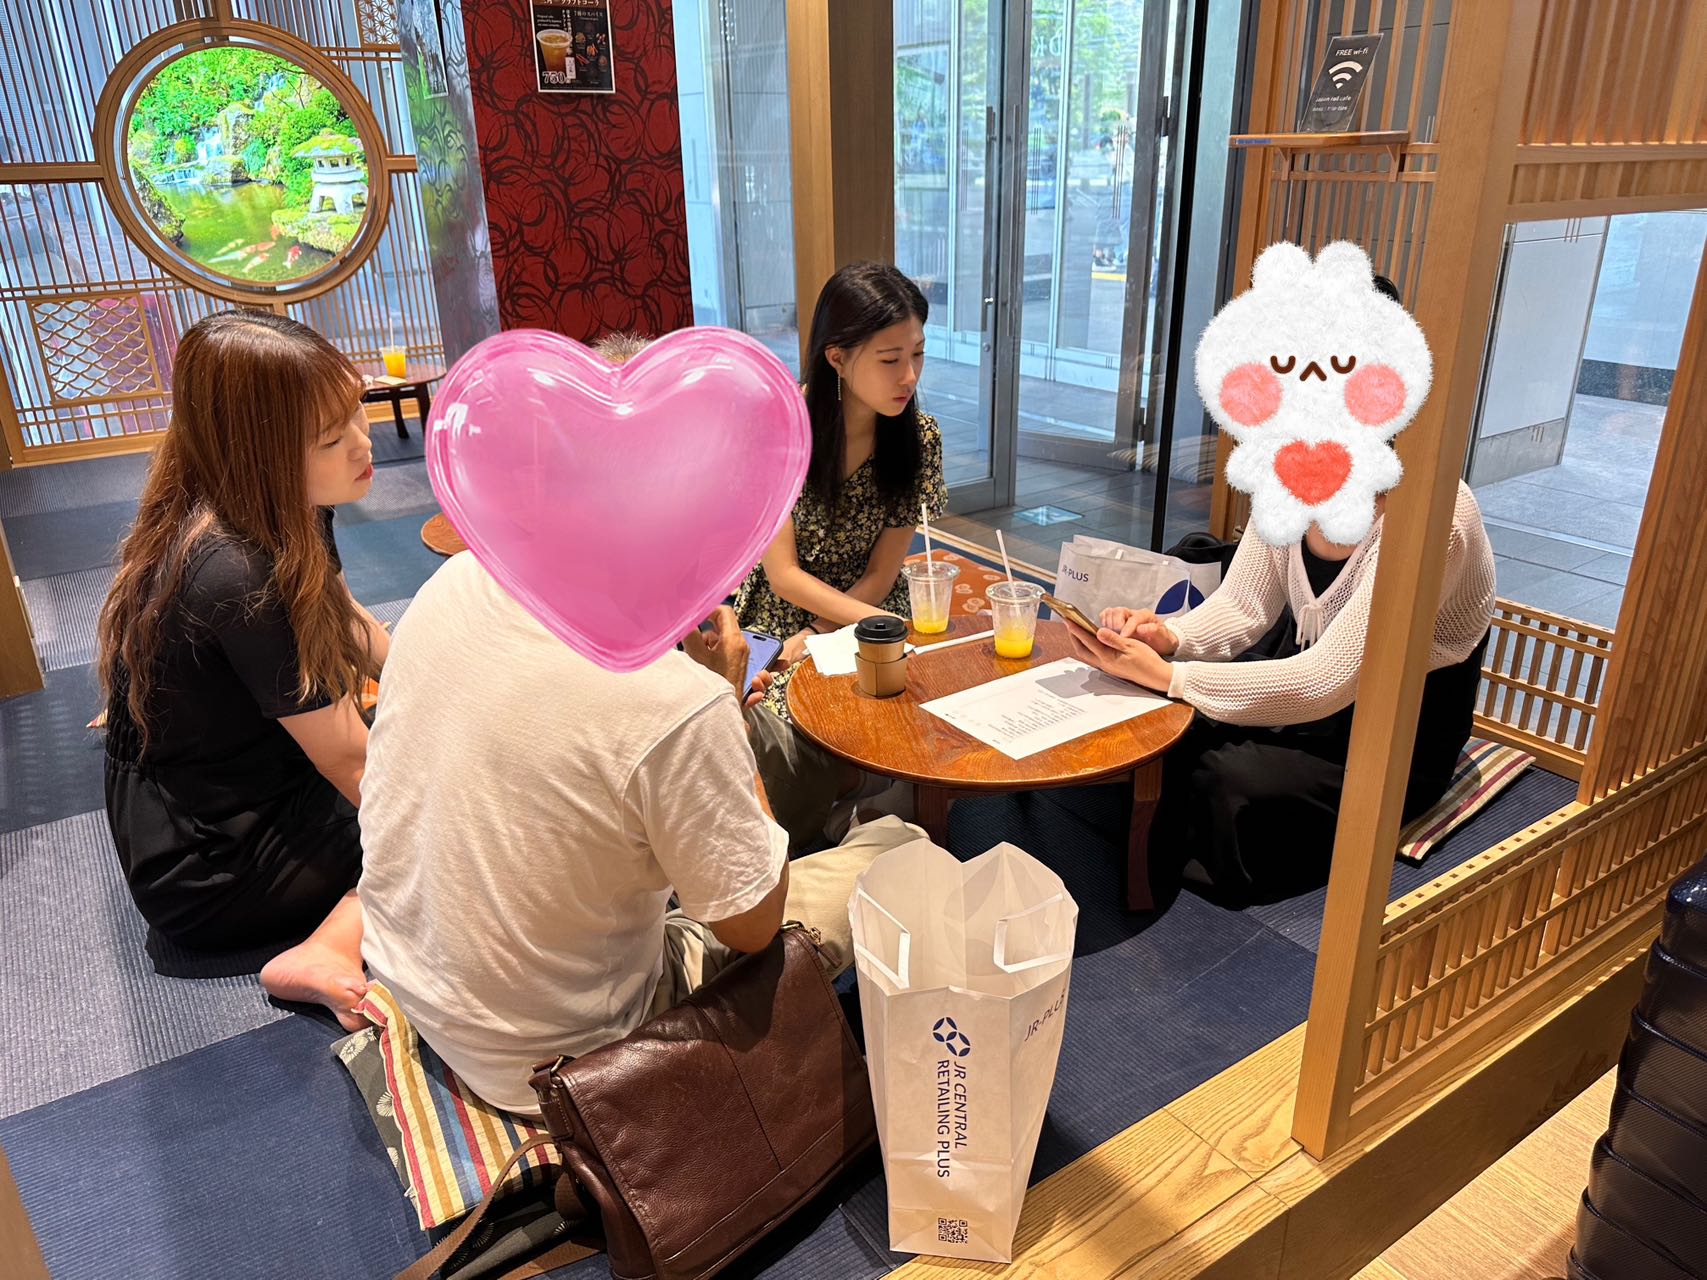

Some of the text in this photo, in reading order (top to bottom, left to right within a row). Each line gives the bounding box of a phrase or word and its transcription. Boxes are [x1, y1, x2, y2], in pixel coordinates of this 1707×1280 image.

[1335, 47, 1368, 56] FREE wi-fi
[936, 1059, 950, 1179] RETAILING PLUS
[953, 1061, 968, 1150] JR CENTRAL
